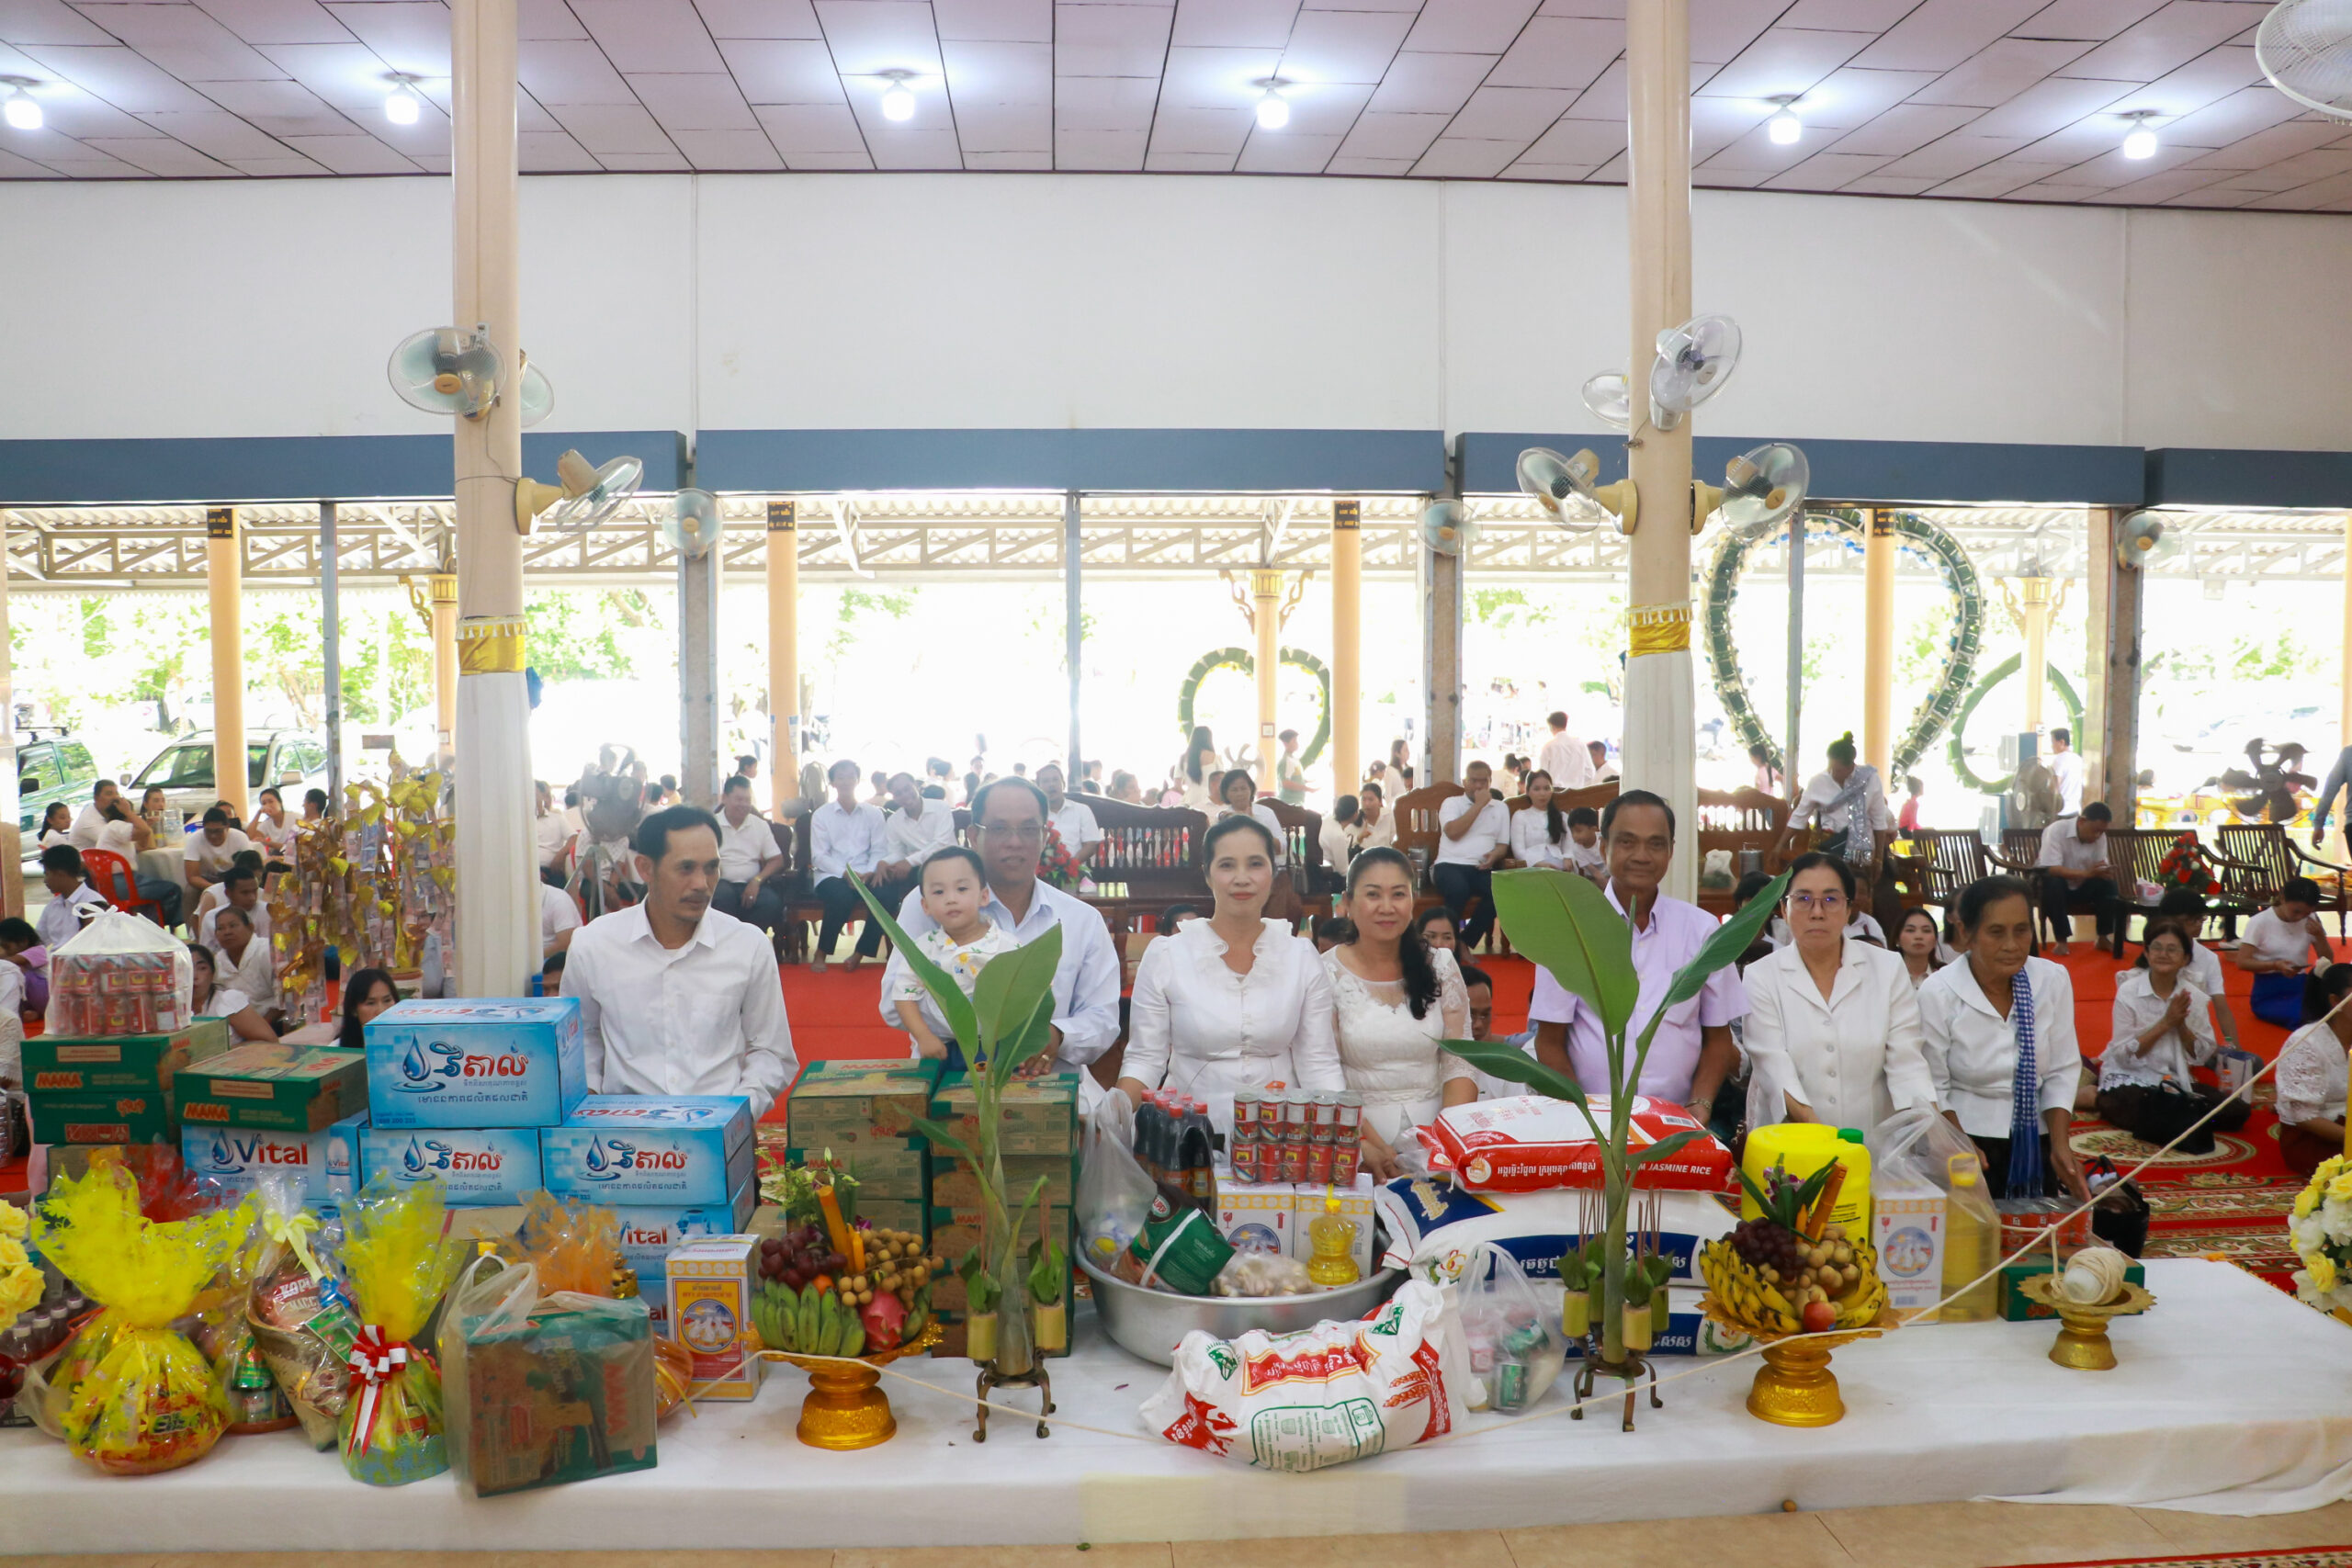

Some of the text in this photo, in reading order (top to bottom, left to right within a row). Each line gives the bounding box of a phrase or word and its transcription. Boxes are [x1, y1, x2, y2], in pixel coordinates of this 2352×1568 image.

[34, 1071, 84, 1089] MAMA
[184, 1102, 230, 1122] MAMA
[233, 1133, 308, 1165] Vital
[1648, 1163, 1689, 1173] JASMINE
[1690, 1166, 1713, 1176] RICE
